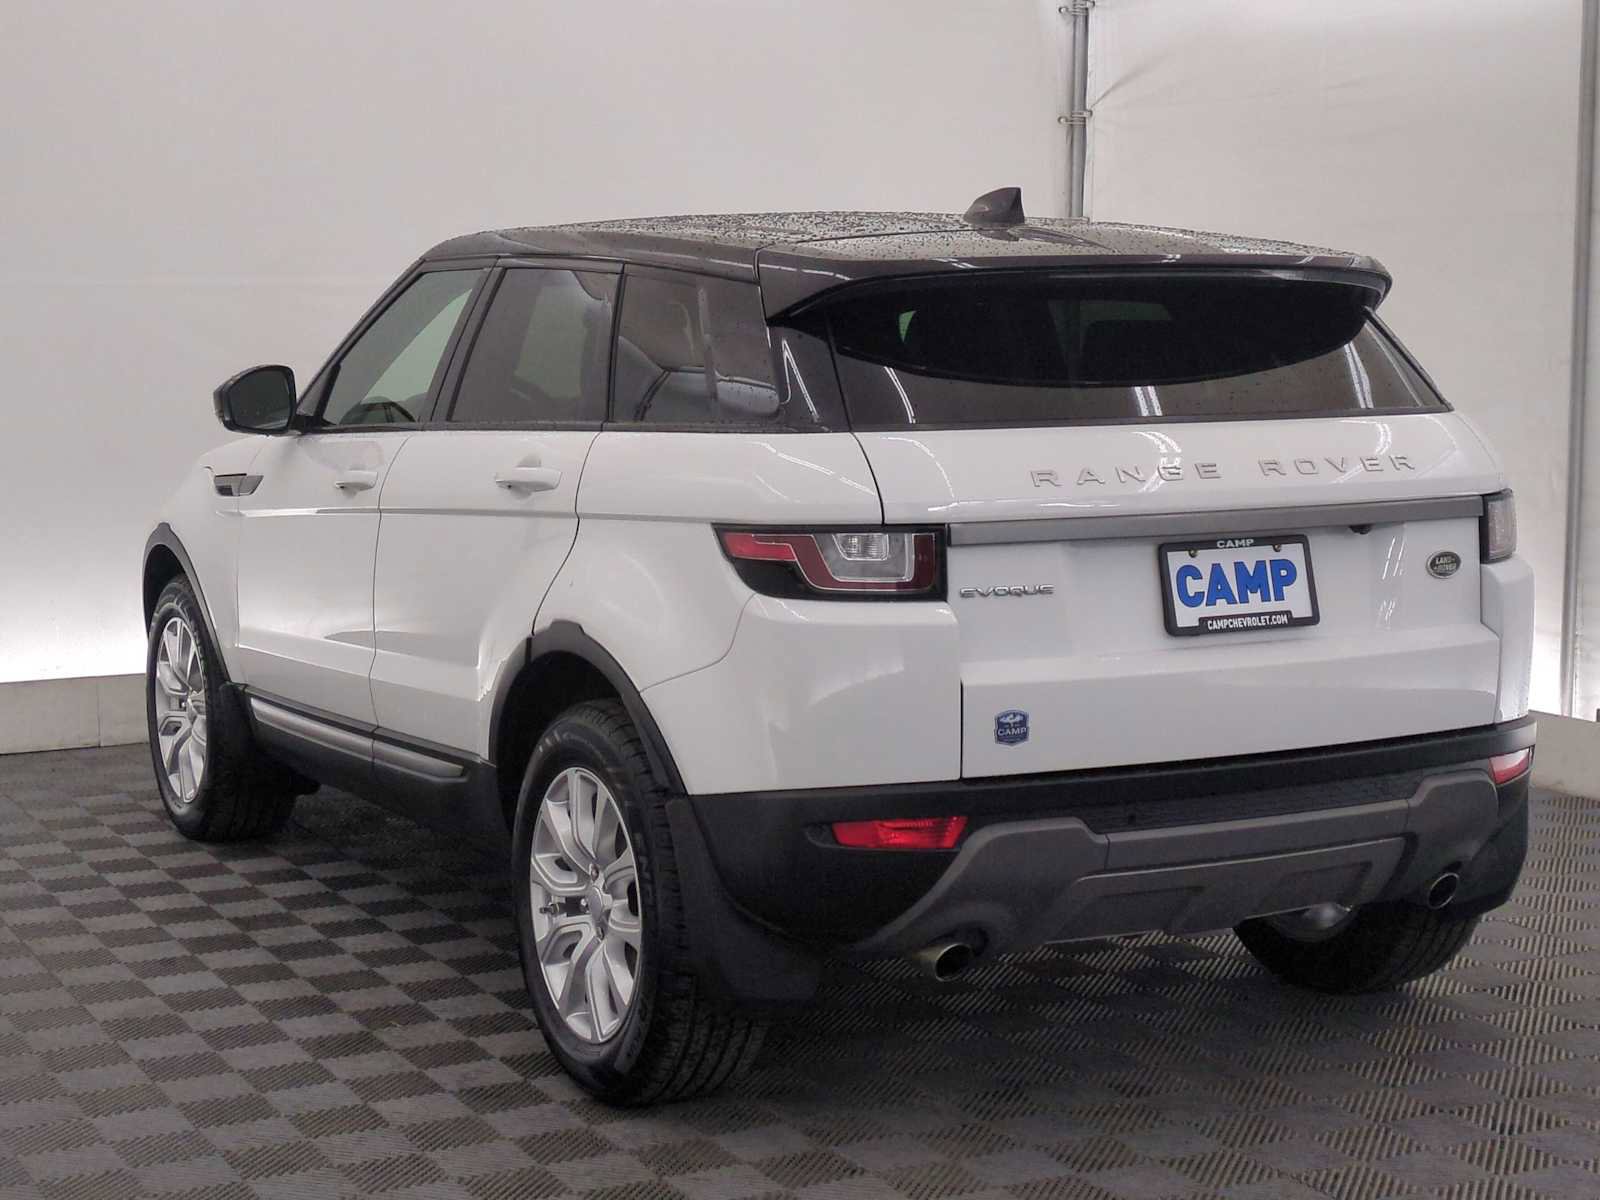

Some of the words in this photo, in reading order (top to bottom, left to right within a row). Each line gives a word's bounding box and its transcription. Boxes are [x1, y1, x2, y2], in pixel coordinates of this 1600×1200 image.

[1030, 463, 1222, 487] RANGE
[1258, 454, 1415, 476] ROVER
[1216, 538, 1254, 549] CAMP
[1175, 558, 1298, 608] CAMP
[960, 584, 1055, 598] EVOQUE
[1207, 614, 1289, 630] CAMPCHEVROLET.COM
[998, 727, 1027, 736] CAMP
